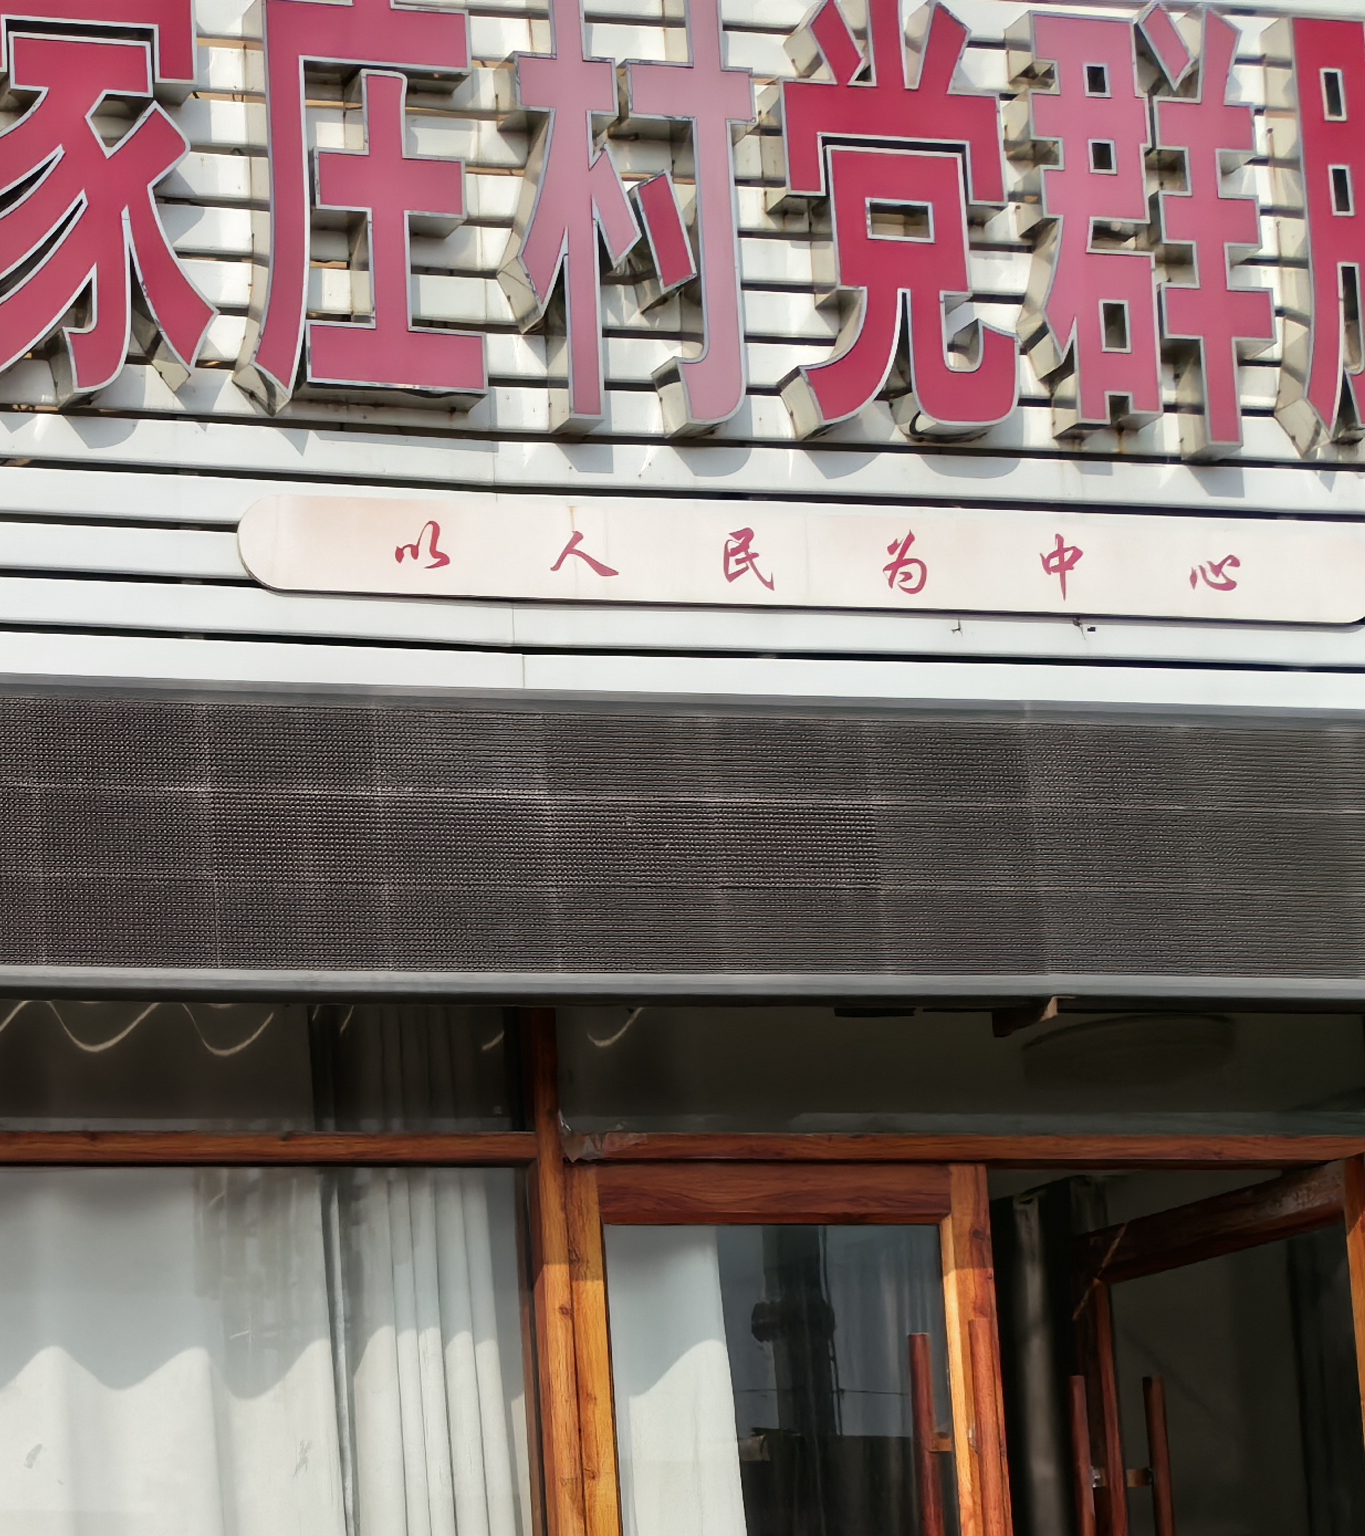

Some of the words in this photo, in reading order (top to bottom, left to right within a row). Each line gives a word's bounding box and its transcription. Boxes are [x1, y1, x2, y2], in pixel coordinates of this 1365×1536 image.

[395, 521, 1240, 596] 以人民为中心
